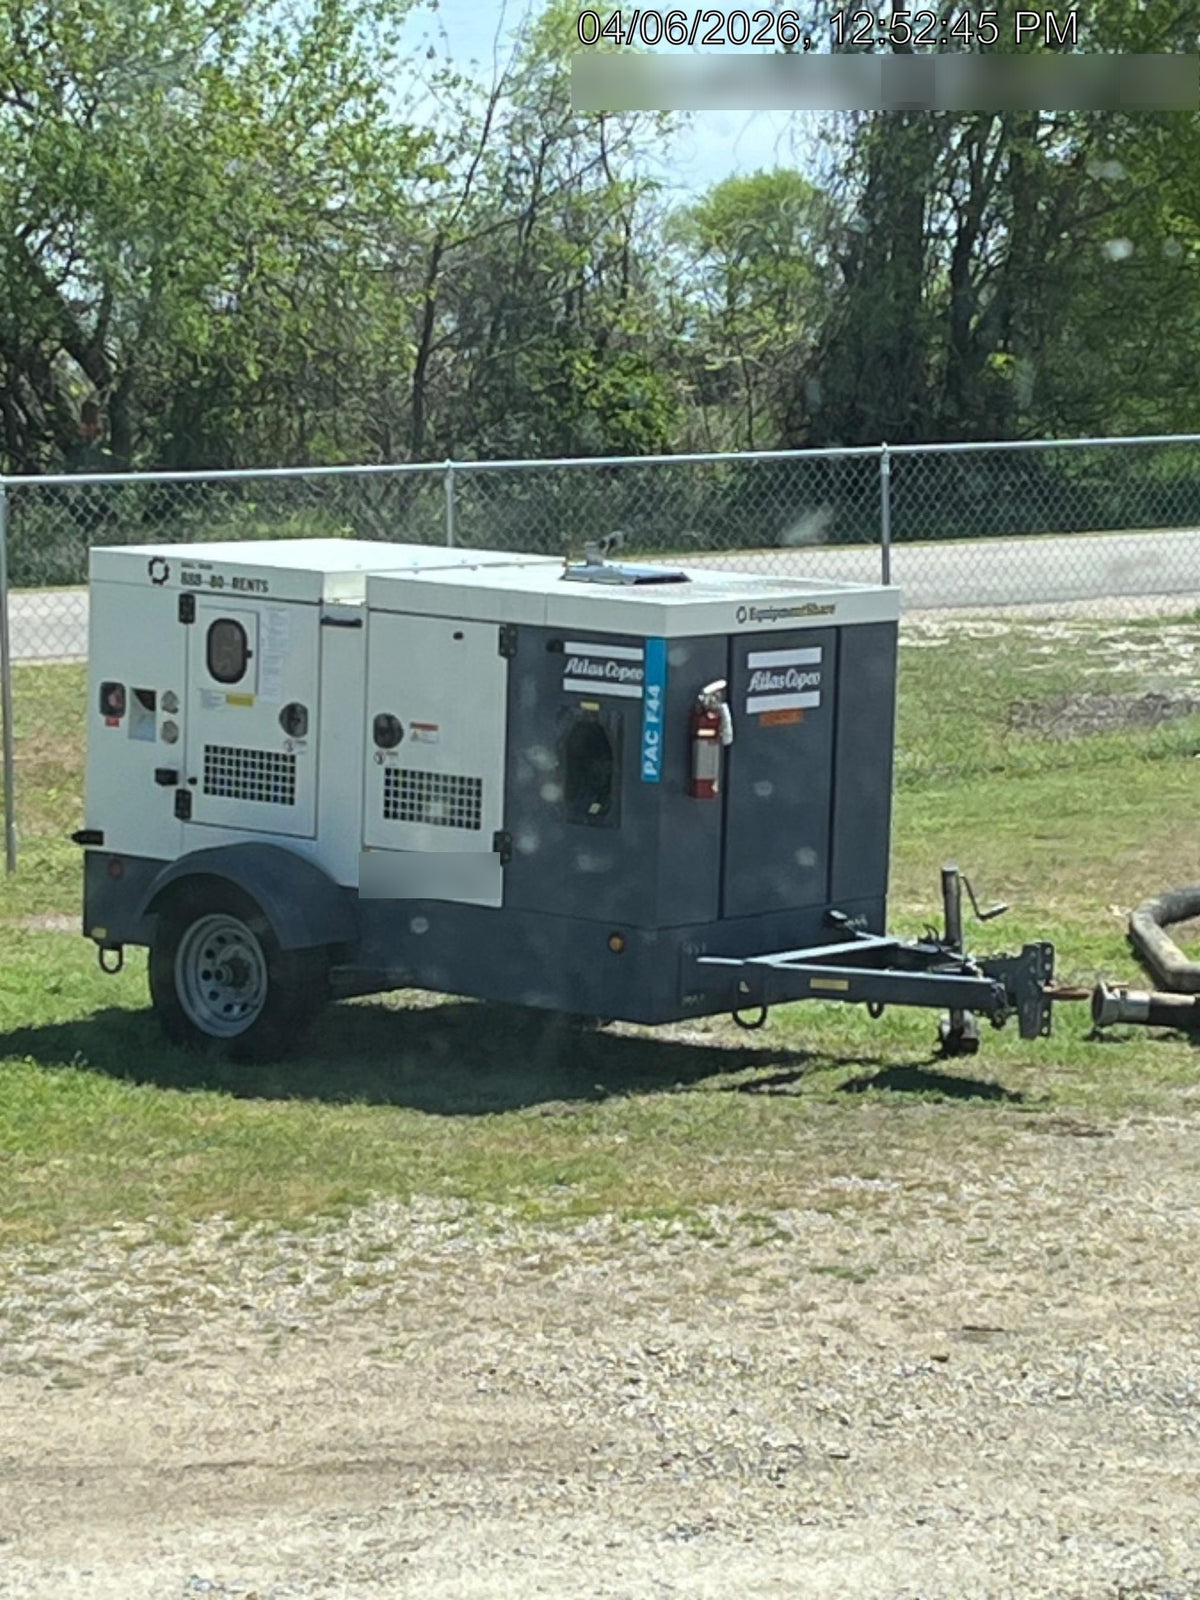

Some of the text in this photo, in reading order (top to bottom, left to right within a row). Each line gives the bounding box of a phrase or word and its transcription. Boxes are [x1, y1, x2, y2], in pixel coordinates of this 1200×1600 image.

[564, 657, 644, 681] Atlas Copco
[747, 668, 821, 693] Atlas Copco
[643, 683, 662, 776] PAC F44
